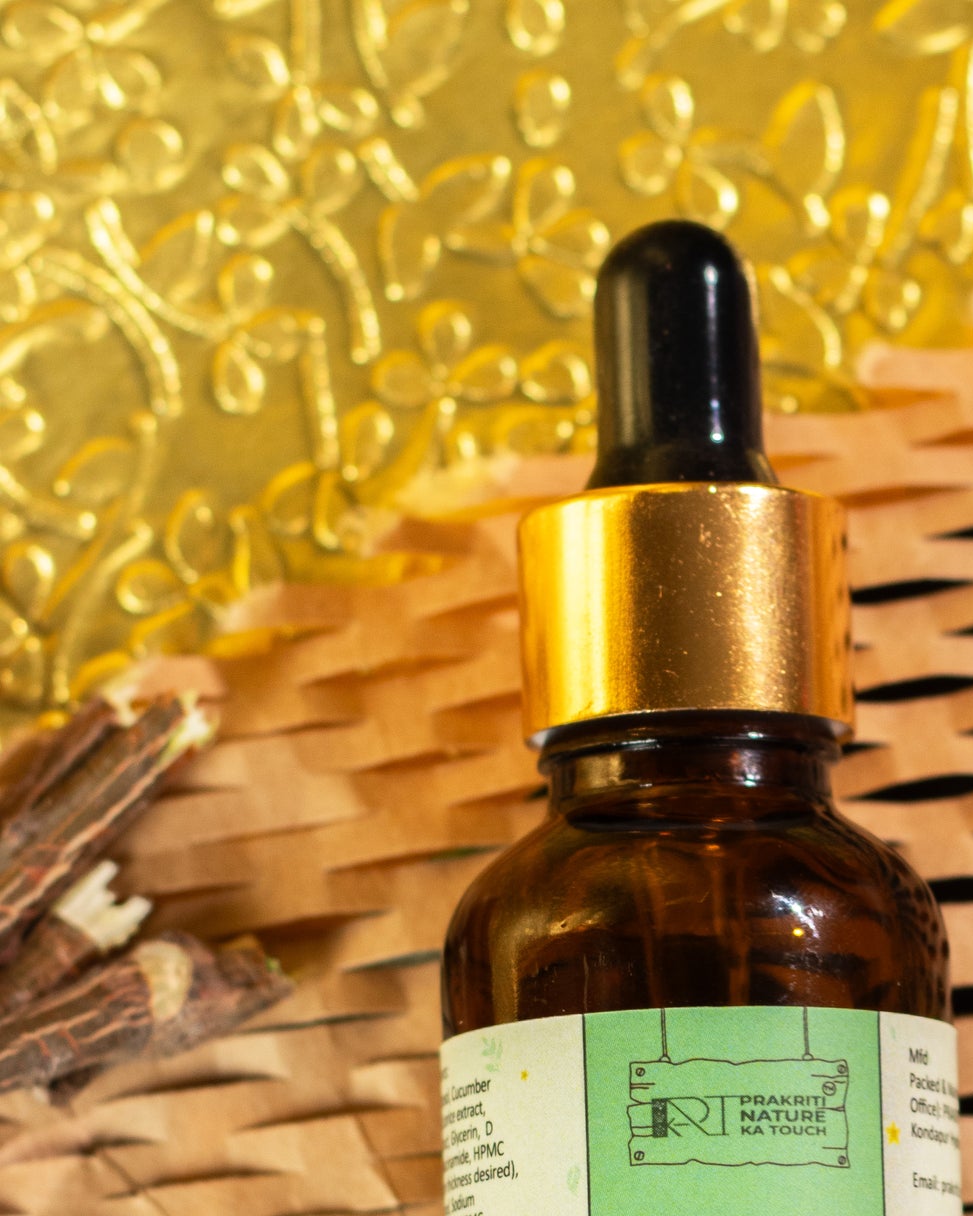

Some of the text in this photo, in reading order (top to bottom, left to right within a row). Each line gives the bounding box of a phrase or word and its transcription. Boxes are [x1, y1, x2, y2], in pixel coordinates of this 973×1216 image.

[451, 1077, 491, 1101] Cucumber
[740, 1095, 827, 1107] PRAKRITI
[456, 1101, 486, 1121] extract,
[740, 1109, 827, 1123] NATURE
[485, 1120, 494, 1136] D
[740, 1125, 827, 1136] KA TOUCH
[473, 1141, 504, 1160] HPMC
[474, 1160, 519, 1183] desired),
